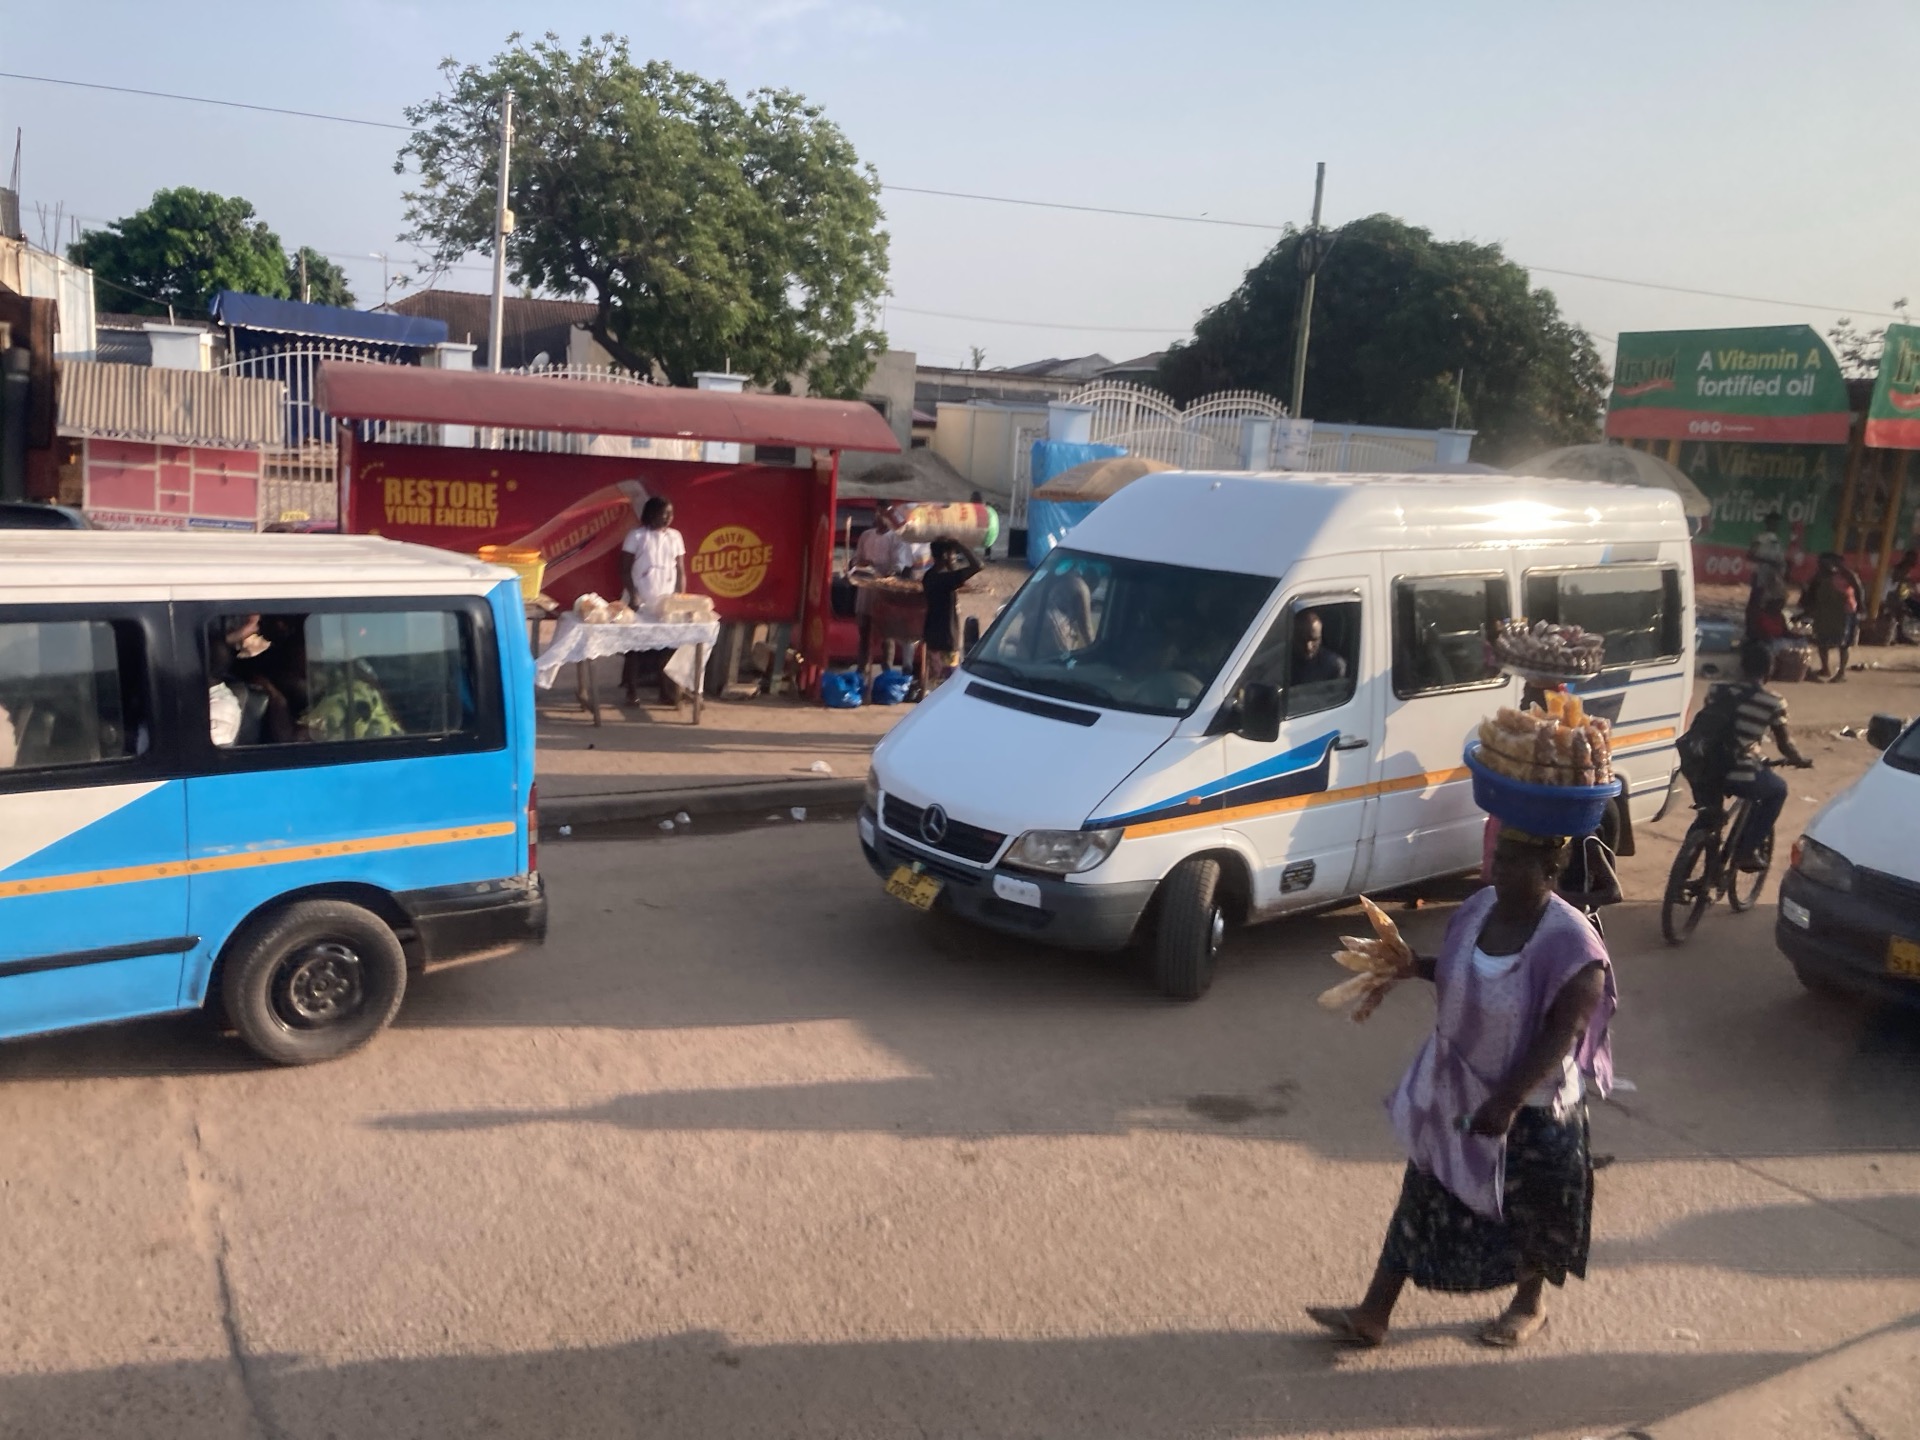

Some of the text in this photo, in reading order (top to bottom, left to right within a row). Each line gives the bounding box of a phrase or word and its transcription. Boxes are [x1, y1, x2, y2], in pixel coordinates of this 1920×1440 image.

[1696, 348, 1822, 371] A Vitamin A
[1697, 374, 1815, 396] fortified oil
[384, 477, 498, 510] RESTORE
[384, 505, 498, 528] YOUR ENERGY
[714, 533, 745, 547] WITH
[691, 545, 773, 573] GLUCOSE
